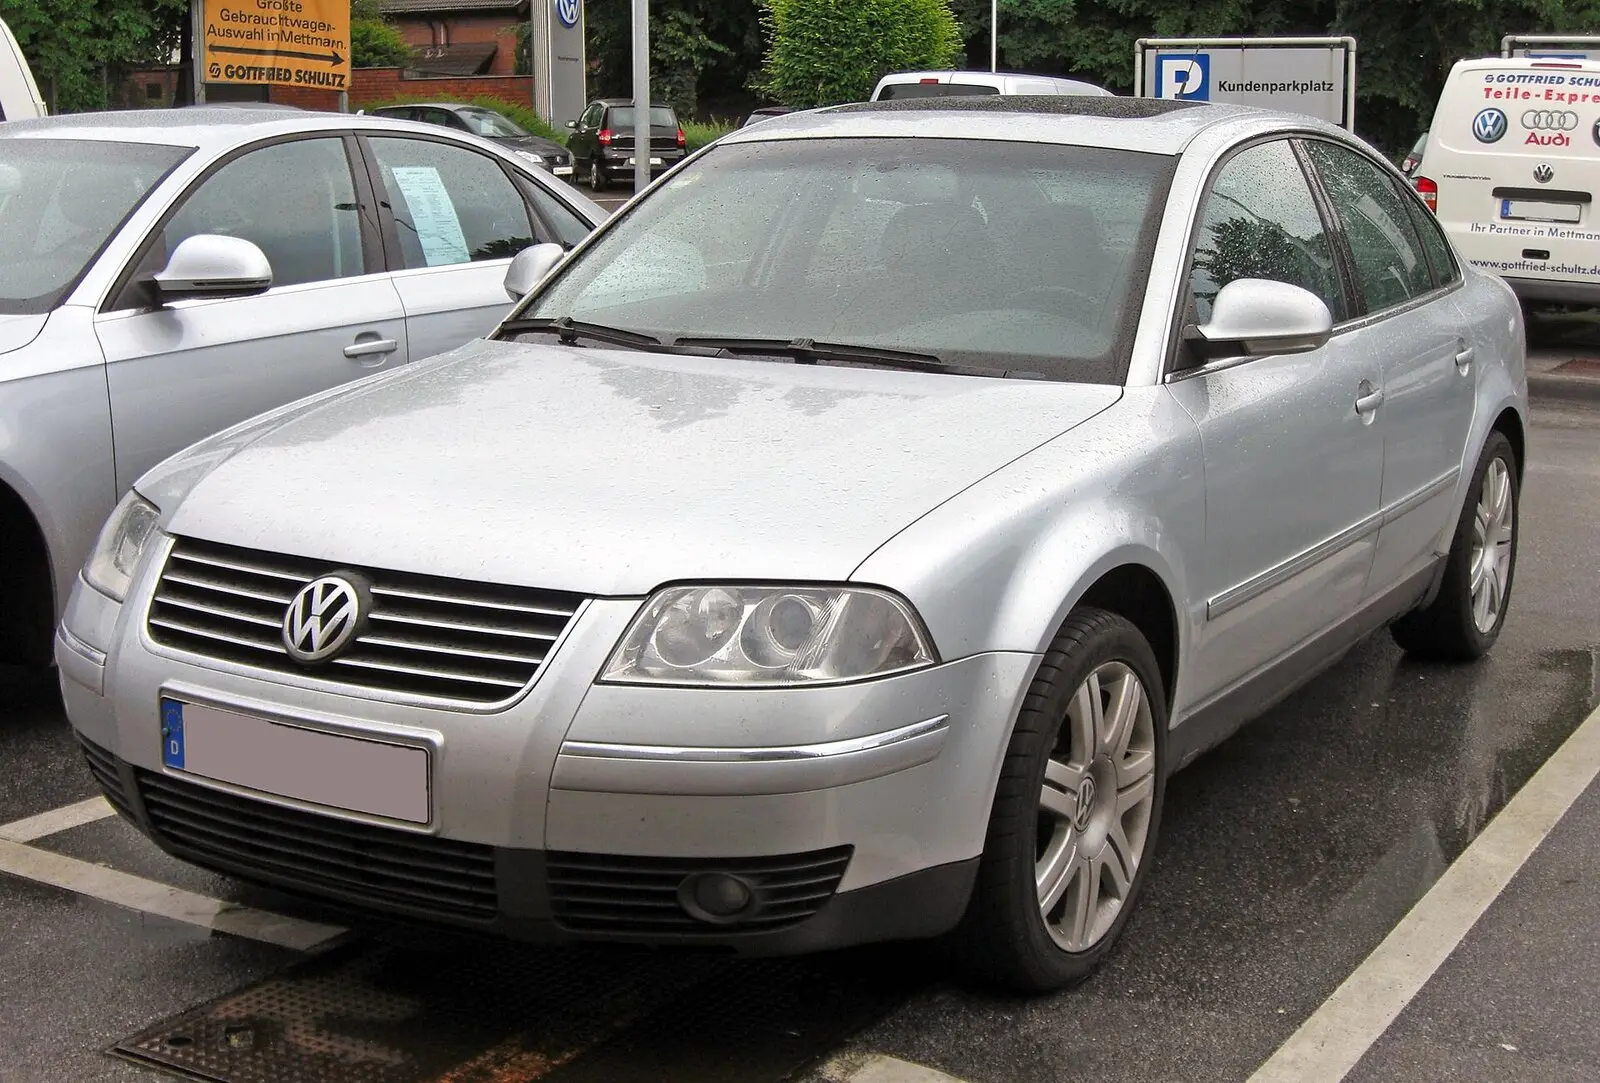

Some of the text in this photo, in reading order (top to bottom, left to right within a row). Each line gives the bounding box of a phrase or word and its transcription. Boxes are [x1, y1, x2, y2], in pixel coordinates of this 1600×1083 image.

[207, 24, 264, 41] Auswahl
[267, 29, 280, 42] in
[295, 69, 346, 88] SCHULTZ
[1497, 74, 1565, 86] GOTTFRIED
[1218, 80, 1334, 95] Kundenparkplatz
[1524, 132, 1570, 147] Audi
[1471, 223, 1600, 241] Ihr Partner in Mettman
[282, 576, 359, 662] VW
[170, 740, 179, 755] D
